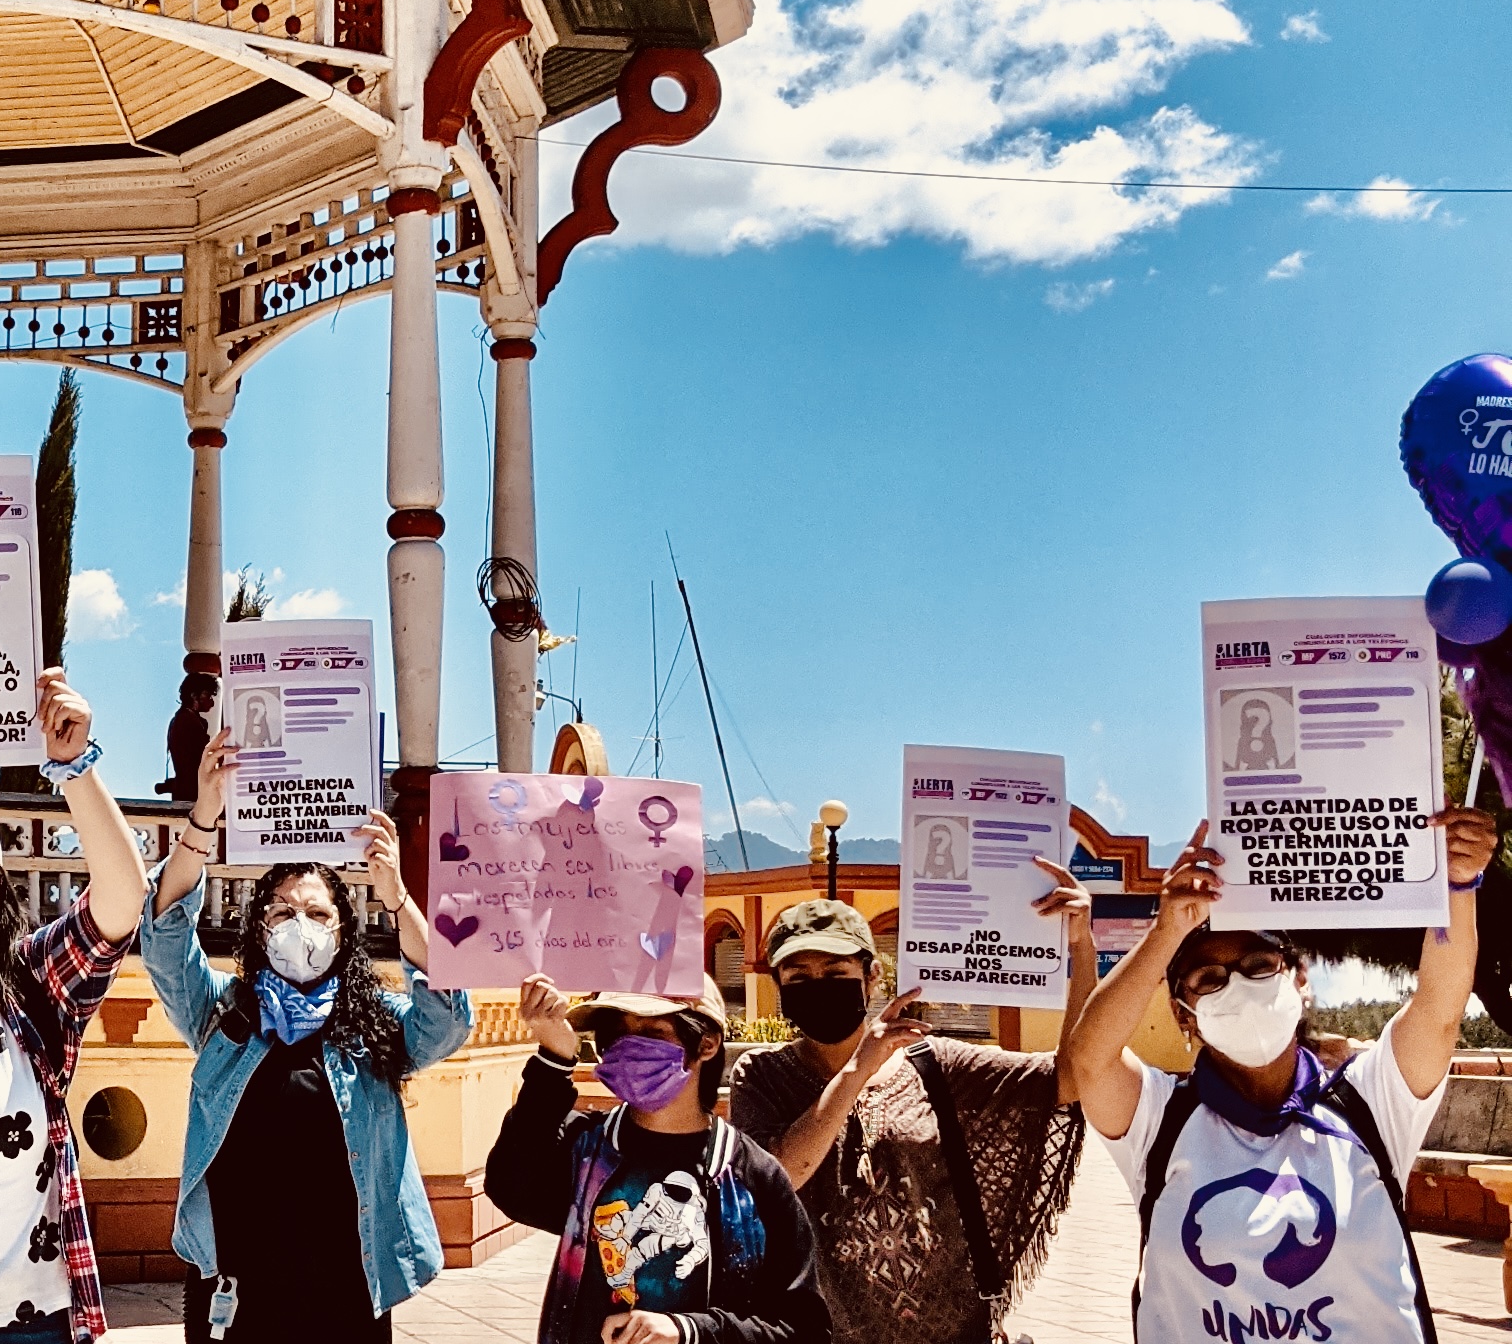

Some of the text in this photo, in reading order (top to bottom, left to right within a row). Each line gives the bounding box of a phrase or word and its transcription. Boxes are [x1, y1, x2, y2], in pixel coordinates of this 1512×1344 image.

[1469, 453, 1487, 474] LO
[1216, 642, 1270, 658] ALERTA
[230, 652, 265, 666] ALERTA
[5, 678, 17, 691] O
[248, 778, 354, 792] LA VIOLENCIA
[913, 778, 953, 792] ALERTA
[257, 792, 346, 805] CONTRA LA
[1230, 797, 1417, 816] LA CANTIDAD DE
[238, 806, 292, 819] MUJER
[274, 819, 329, 831] ES UNA
[1220, 815, 1429, 836] ROPA QUE USO NO
[260, 832, 345, 845] PANDEMIA
[518, 819, 627, 850] mujeres
[1242, 833, 1409, 850] DETERMINA LA
[457, 853, 660, 878] merecen ser libres
[1248, 851, 1404, 867] CANTIDAD DE
[1249, 868, 1404, 887] RESPETO QUE
[588, 878, 617, 898] los
[1270, 886, 1383, 902] MEREZCO
[489, 930, 524, 953] 365
[572, 930, 592, 948] del
[970, 930, 1000, 944] ¡NO
[906, 941, 1061, 960] DESAPARECEMOS,
[965, 957, 1002, 970] NOS
[919, 969, 1046, 986] DESAPARECEN!
